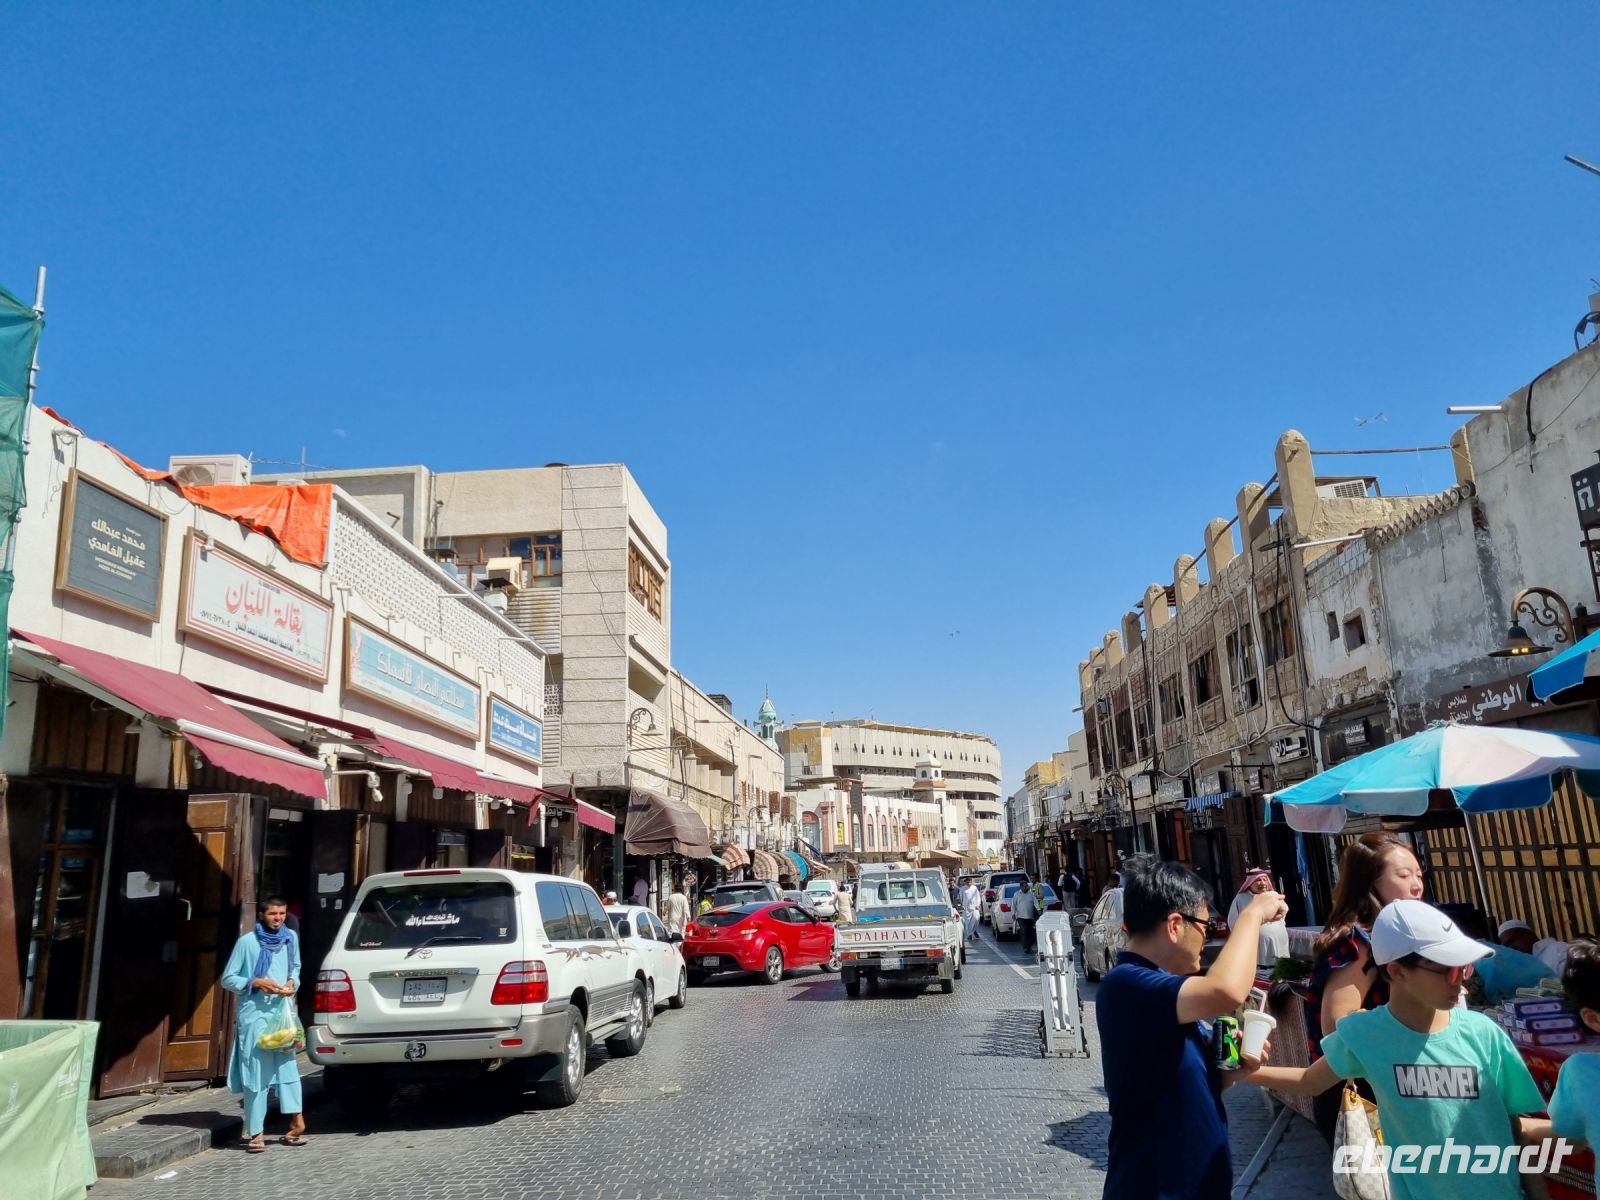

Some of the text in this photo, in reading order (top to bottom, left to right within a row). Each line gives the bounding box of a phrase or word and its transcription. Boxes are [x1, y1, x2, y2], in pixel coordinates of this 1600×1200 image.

[91, 518, 121, 540] عبدالله
[88, 536, 123, 559] الغامدي
[121, 534, 146, 550] محمد
[122, 551, 146, 569] عقيل
[274, 602, 302, 646] بقالة
[1471, 682, 1522, 721] الوطني
[853, 929, 927, 942] DAIHATSU
[1396, 1066, 1478, 1097] MARVEL
